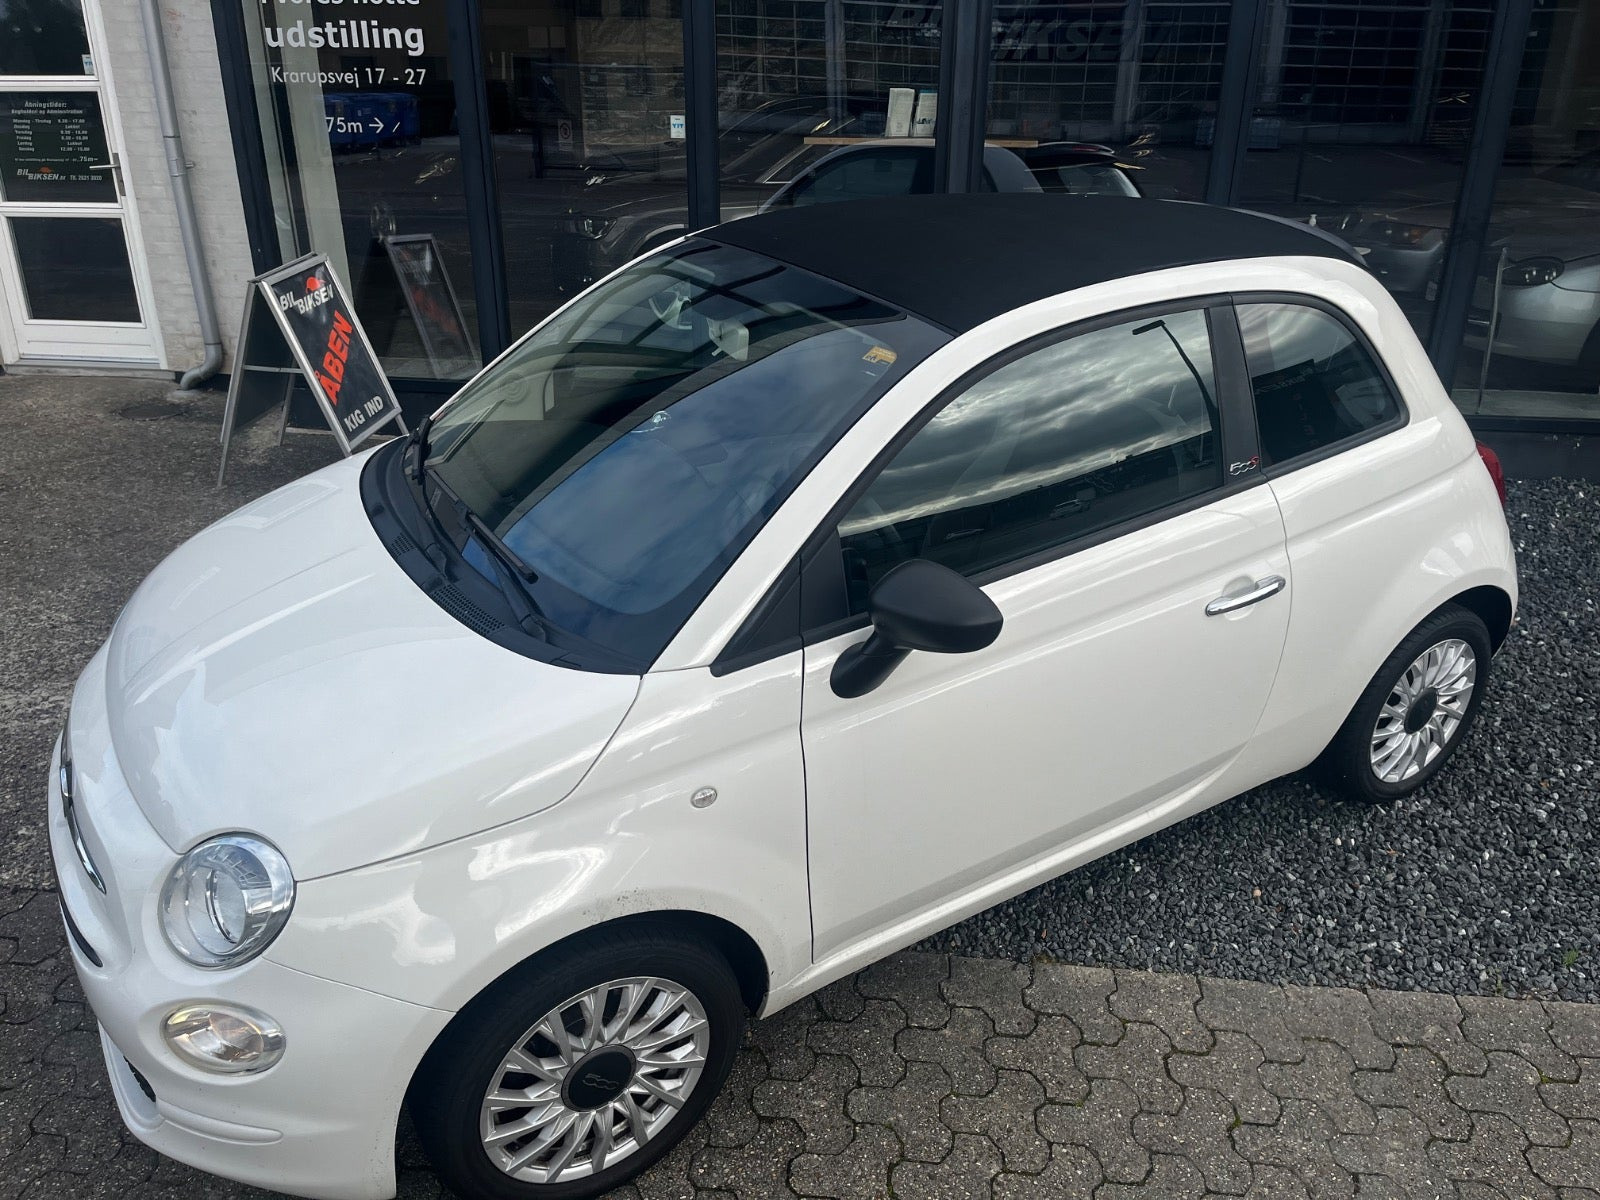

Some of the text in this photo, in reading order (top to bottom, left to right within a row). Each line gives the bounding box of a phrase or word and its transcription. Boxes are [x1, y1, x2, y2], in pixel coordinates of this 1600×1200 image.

[265, 20, 425, 57] udstilling
[271, 66, 360, 89] Krarupsvej
[365, 67, 385, 85] 17
[404, 68, 427, 86] 27
[24, 100, 67, 109] Åbningstider:
[326, 117, 363, 133] 75m
[17, 168, 30, 176] BIL
[279, 291, 299, 312] BIL
[296, 284, 334, 315] BIKSEN
[314, 309, 354, 406] ÅBEN
[343, 395, 384, 432] KIG IND
